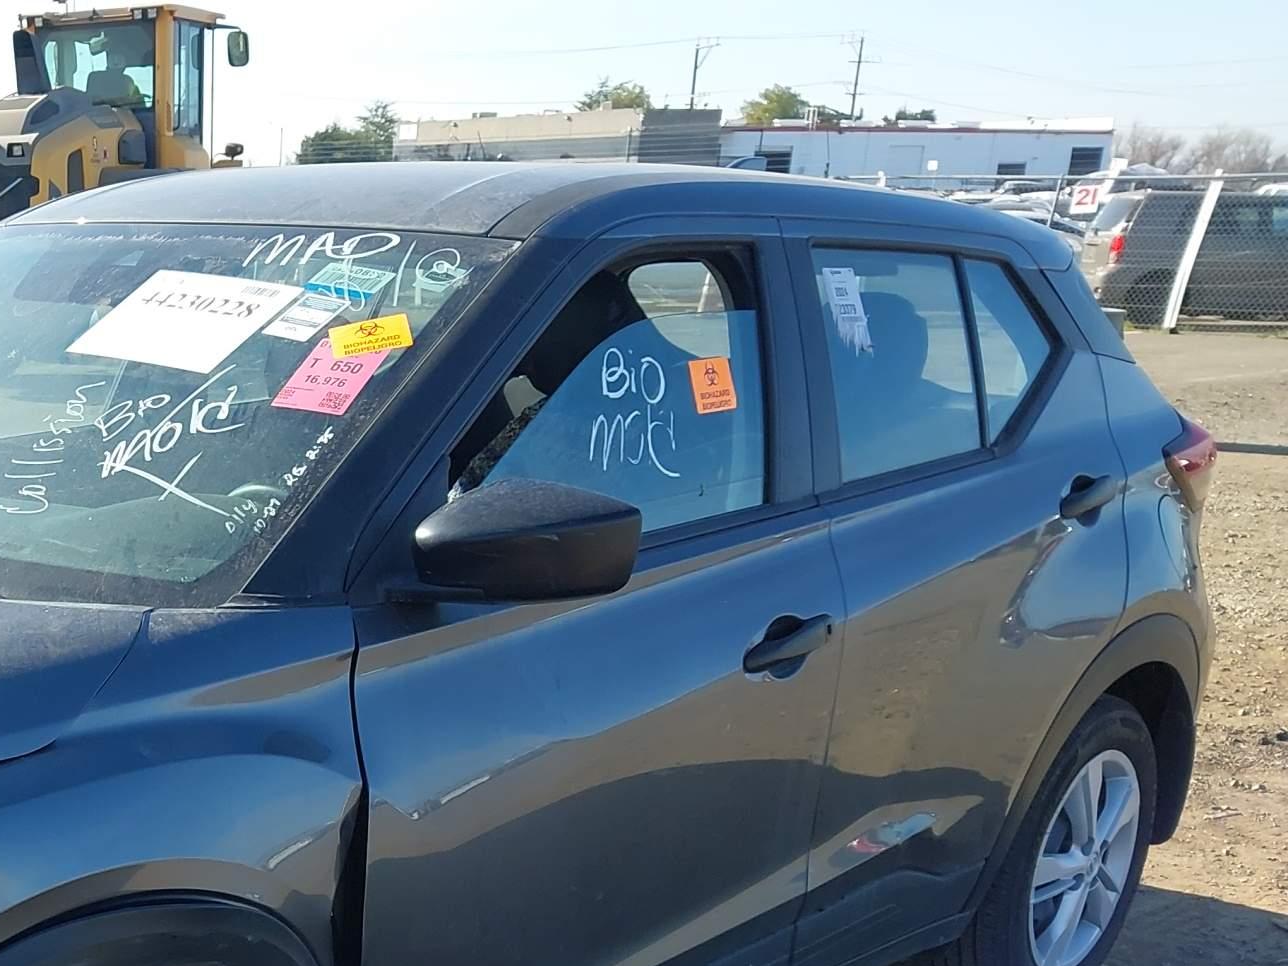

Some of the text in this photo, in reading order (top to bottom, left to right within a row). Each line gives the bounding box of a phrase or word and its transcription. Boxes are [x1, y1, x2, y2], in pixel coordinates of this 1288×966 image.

[1075, 188, 1098, 205] 21
[141, 290, 261, 318] 44230228
[343, 334, 401, 350] BIOHAZARD
[310, 357, 364, 375] T 650
[304, 374, 348, 388] 16,976
